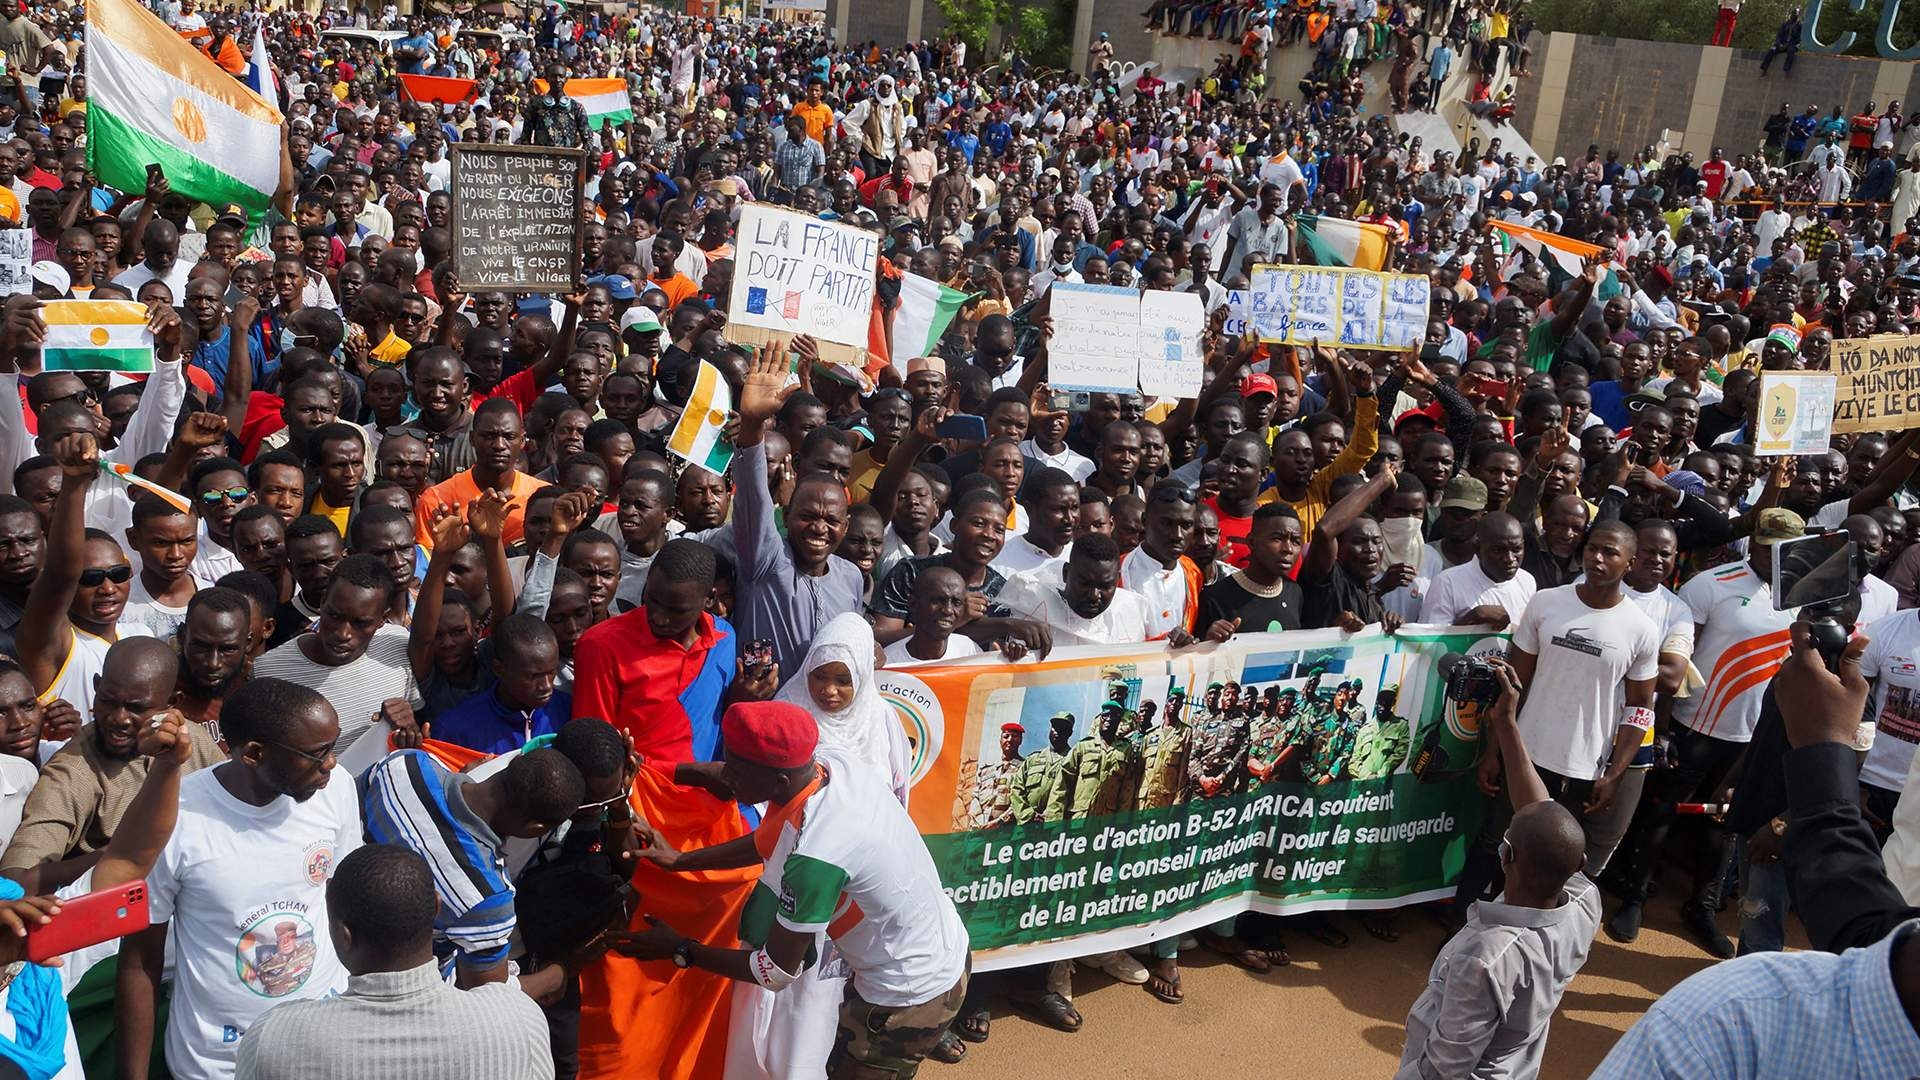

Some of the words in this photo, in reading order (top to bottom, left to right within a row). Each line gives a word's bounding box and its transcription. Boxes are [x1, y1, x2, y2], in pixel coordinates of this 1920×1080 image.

[460, 153, 497, 170] NOUS
[458, 172, 503, 185] VERAIN
[507, 174, 522, 185] DU
[528, 173, 574, 188] NIGER
[462, 227, 481, 238] DE
[755, 217, 791, 249] LA
[802, 223, 877, 273] FRANCE
[462, 246, 478, 257] DE
[528, 257, 567, 270] CNSP
[514, 269, 527, 282] LE
[1264, 267, 1380, 299] TOUTES
[1391, 276, 1429, 305] LES
[1252, 291, 1329, 315] BASES
[1342, 299, 1366, 317] DE
[1276, 315, 1329, 342] france
[1870, 346, 1891, 369] DA
[1832, 396, 1877, 424] VIVE
[1883, 394, 1903, 416] LE
[879, 682, 932, 710] d'action
[983, 843, 1012, 867] Le
[1019, 833, 1087, 861] cadre
[1093, 820, 1181, 852] d'action
[1185, 807, 1237, 838] B-52
[1238, 795, 1315, 826] AFRICA
[1319, 789, 1395, 818] soutient
[1092, 863, 1115, 886] le
[1119, 848, 1197, 881] conseil
[1200, 826, 1276, 866] national
[1279, 828, 1331, 855] pour
[1332, 823, 1351, 845] la
[1355, 811, 1456, 845] sauvegarde
[1019, 904, 1050, 930] de
[1054, 900, 1077, 924] la
[1081, 889, 1149, 925] patrie
[1151, 879, 1200, 913] pour
[1201, 860, 1259, 894] libérer
[1263, 858, 1287, 882] le
[1291, 856, 1347, 884] Niger
